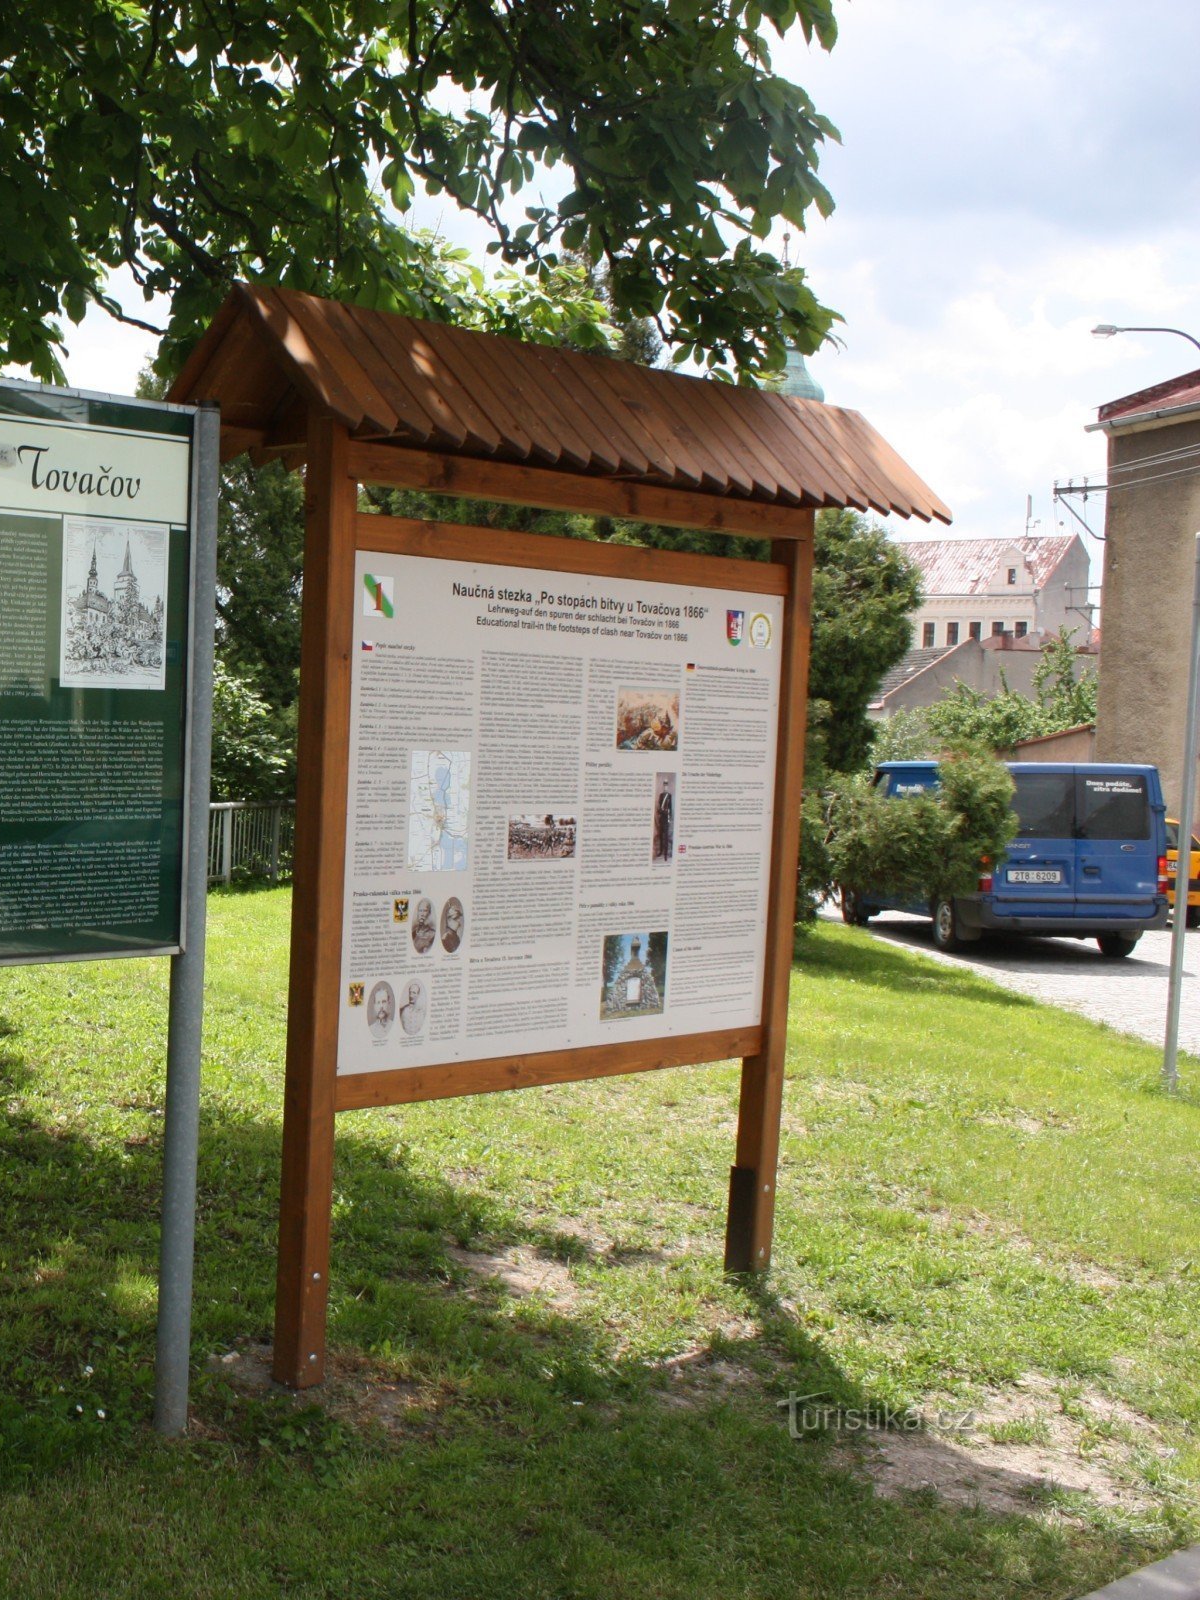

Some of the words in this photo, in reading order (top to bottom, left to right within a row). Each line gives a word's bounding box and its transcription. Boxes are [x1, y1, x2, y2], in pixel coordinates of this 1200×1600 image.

[17, 444, 141, 499] Tovačov
[452, 583, 495, 599] Naučná
[497, 589, 532, 603] stezka
[557, 595, 598, 610] stopách
[600, 597, 625, 615] bitvy
[627, 603, 634, 612] u
[636, 600, 680, 617] Tovačova
[476, 616, 520, 628] Educational
[521, 620, 544, 630] trail-in
[545, 622, 557, 631] the
[558, 623, 591, 635] footsteps
[591, 626, 600, 635] of
[600, 627, 618, 636] clash
[620, 629, 635, 638] near
[636, 629, 662, 640] Tovačov
[673, 633, 688, 642] 1866
[487, 603, 534, 617] Lehrweg-auf
[534, 608, 548, 617] den
[549, 611, 574, 620] spuren
[575, 612, 586, 620] der
[587, 613, 616, 624] schlacht
[617, 616, 628, 625] bei
[629, 617, 656, 627] Tovačov
[657, 619, 664, 627] in
[665, 620, 680, 629] 1866
[1014, 871, 1030, 880] 2T8
[1036, 872, 1057, 880] 6209
